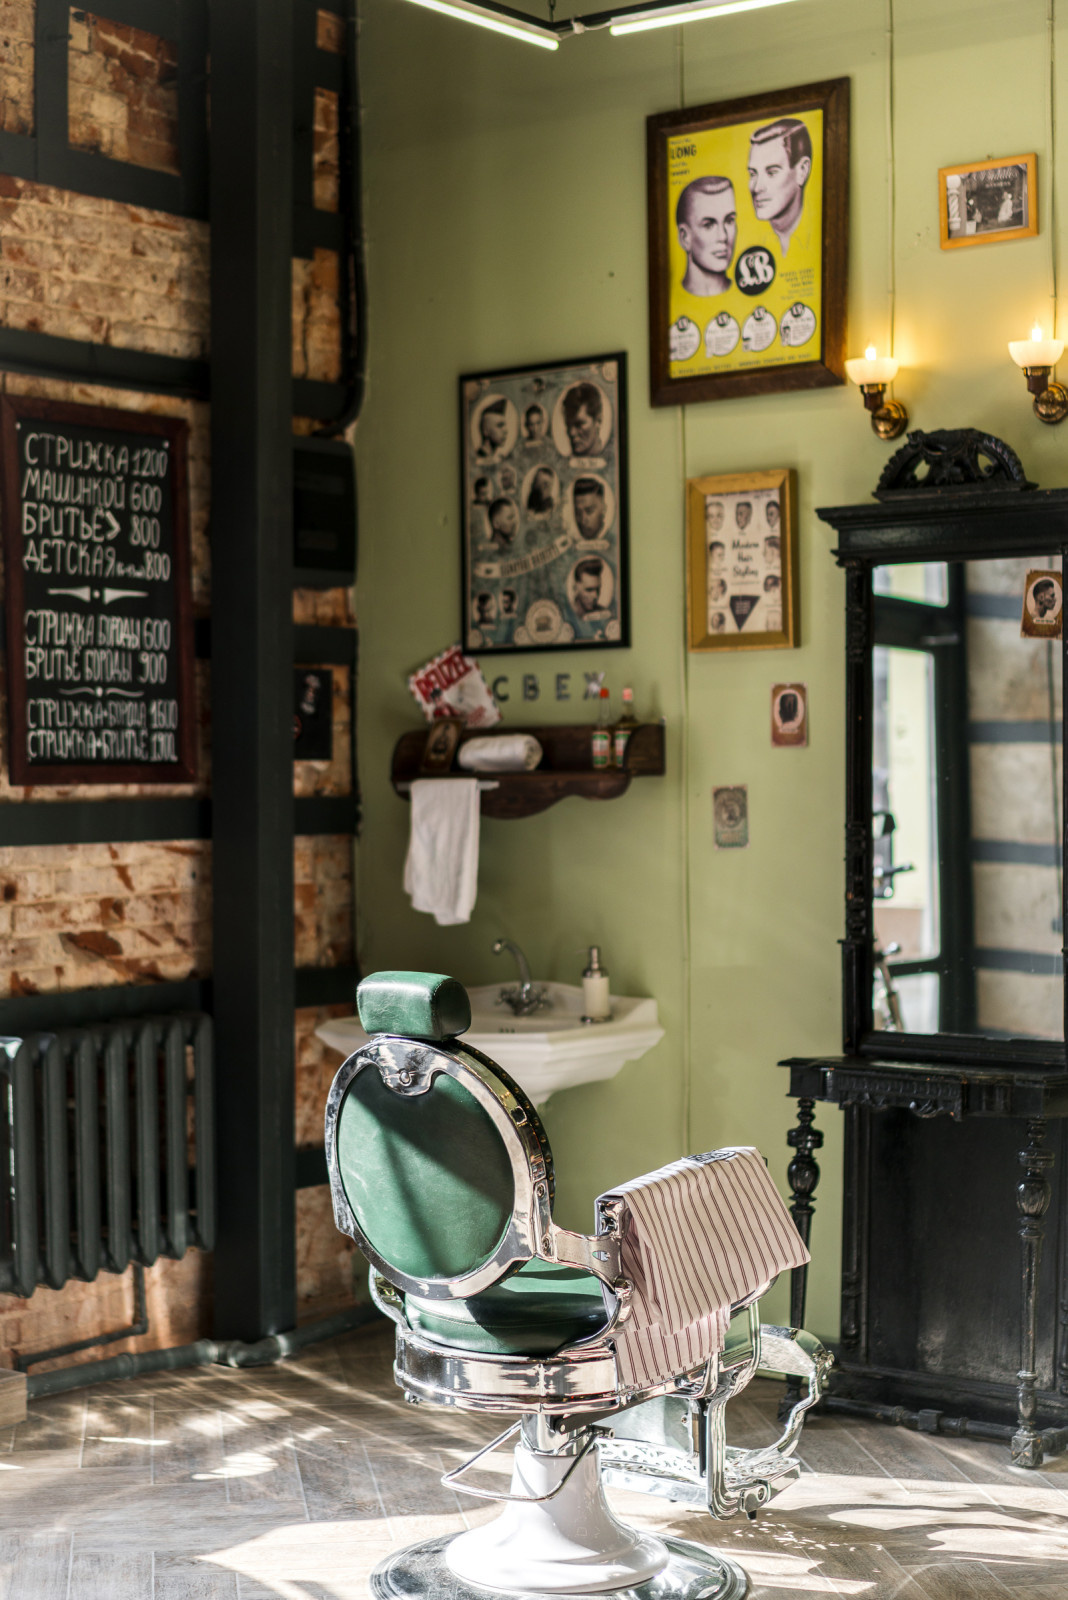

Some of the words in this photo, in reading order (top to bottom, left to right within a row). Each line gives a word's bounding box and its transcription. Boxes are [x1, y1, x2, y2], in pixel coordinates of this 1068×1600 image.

[671, 144, 697, 160] LONG
[25, 432, 129, 474] СТРИЖКА
[132, 447, 168, 478] 1200
[21, 467, 125, 509] МАШИНКОЙ
[130, 481, 162, 513] 600
[130, 514, 160, 549] 800
[22, 538, 116, 578] ДЕТСКАЯ
[145, 551, 171, 580] 800
[25, 609, 95, 646] СТРИЖКА
[98, 614, 140, 650] БОРОДЫ
[143, 617, 171, 650] 600
[85, 648, 132, 683] БОРОДЫ
[138, 651, 167, 684] 900
